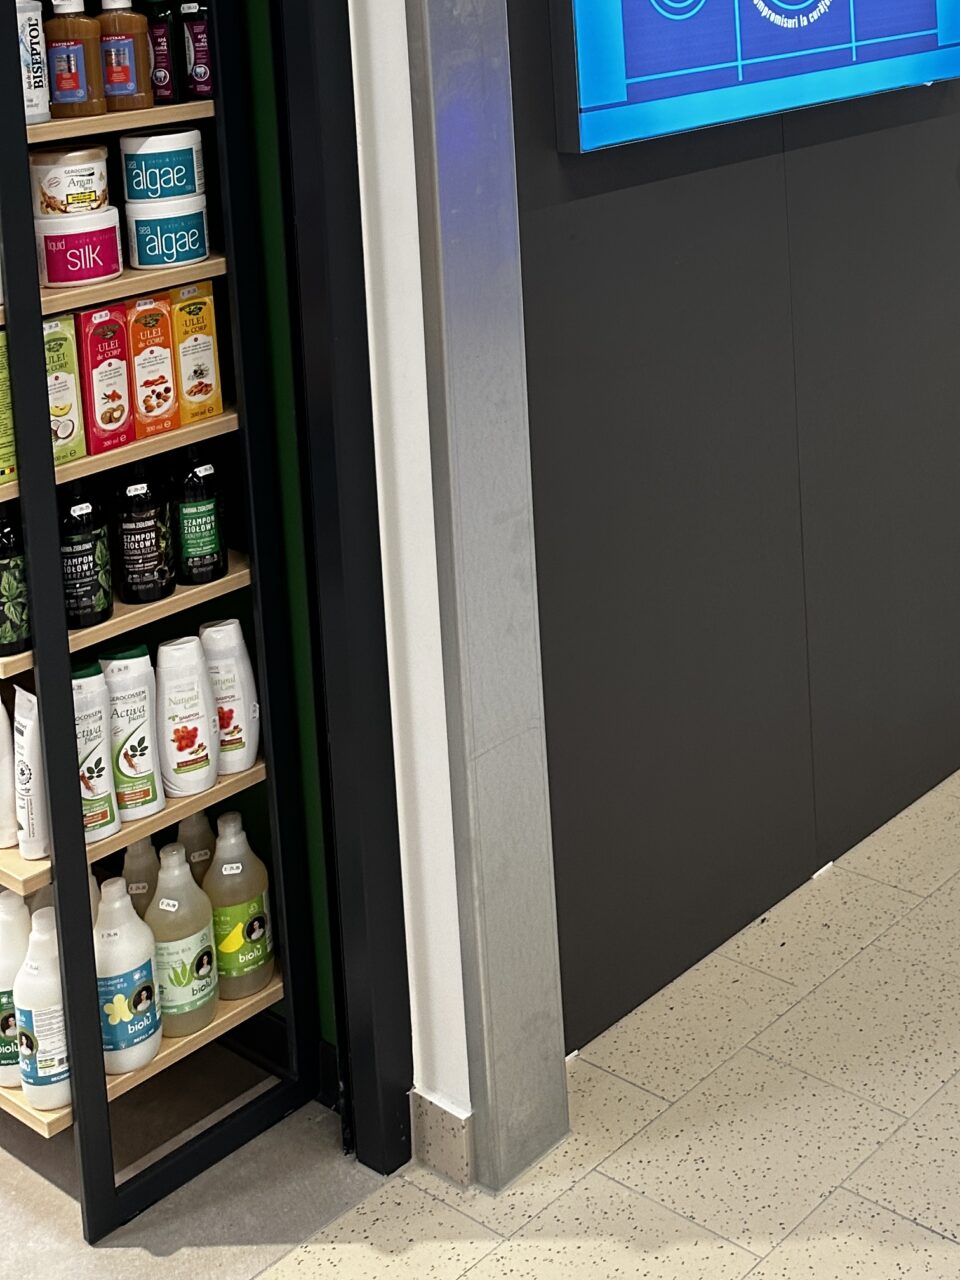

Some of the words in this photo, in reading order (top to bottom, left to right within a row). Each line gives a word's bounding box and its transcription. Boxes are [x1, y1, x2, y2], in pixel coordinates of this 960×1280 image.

[800, 14, 808, 28] la
[28, 19, 44, 90] BISEPTOL
[132, 161, 187, 198] algae
[145, 225, 200, 263] algae
[66, 244, 104, 271] silk
[184, 316, 206, 328] ULEI
[140, 328, 162, 340] ULEI
[191, 324, 207, 335] CORP
[97, 340, 119, 353] ULEI
[146, 336, 164, 347] CORP
[105, 348, 121, 359] CORP
[184, 515, 215, 527] SZAMPON
[123, 531, 156, 542] SZAMPON
[123, 539, 156, 549] ZIOŁOWY
[64, 554, 94, 567] ZAMPON
[64, 562, 94, 574] IOŁOWY
[75, 709, 102, 722] OCOSSEN
[111, 704, 146, 720] Activa
[76, 725, 101, 740] ctiva
